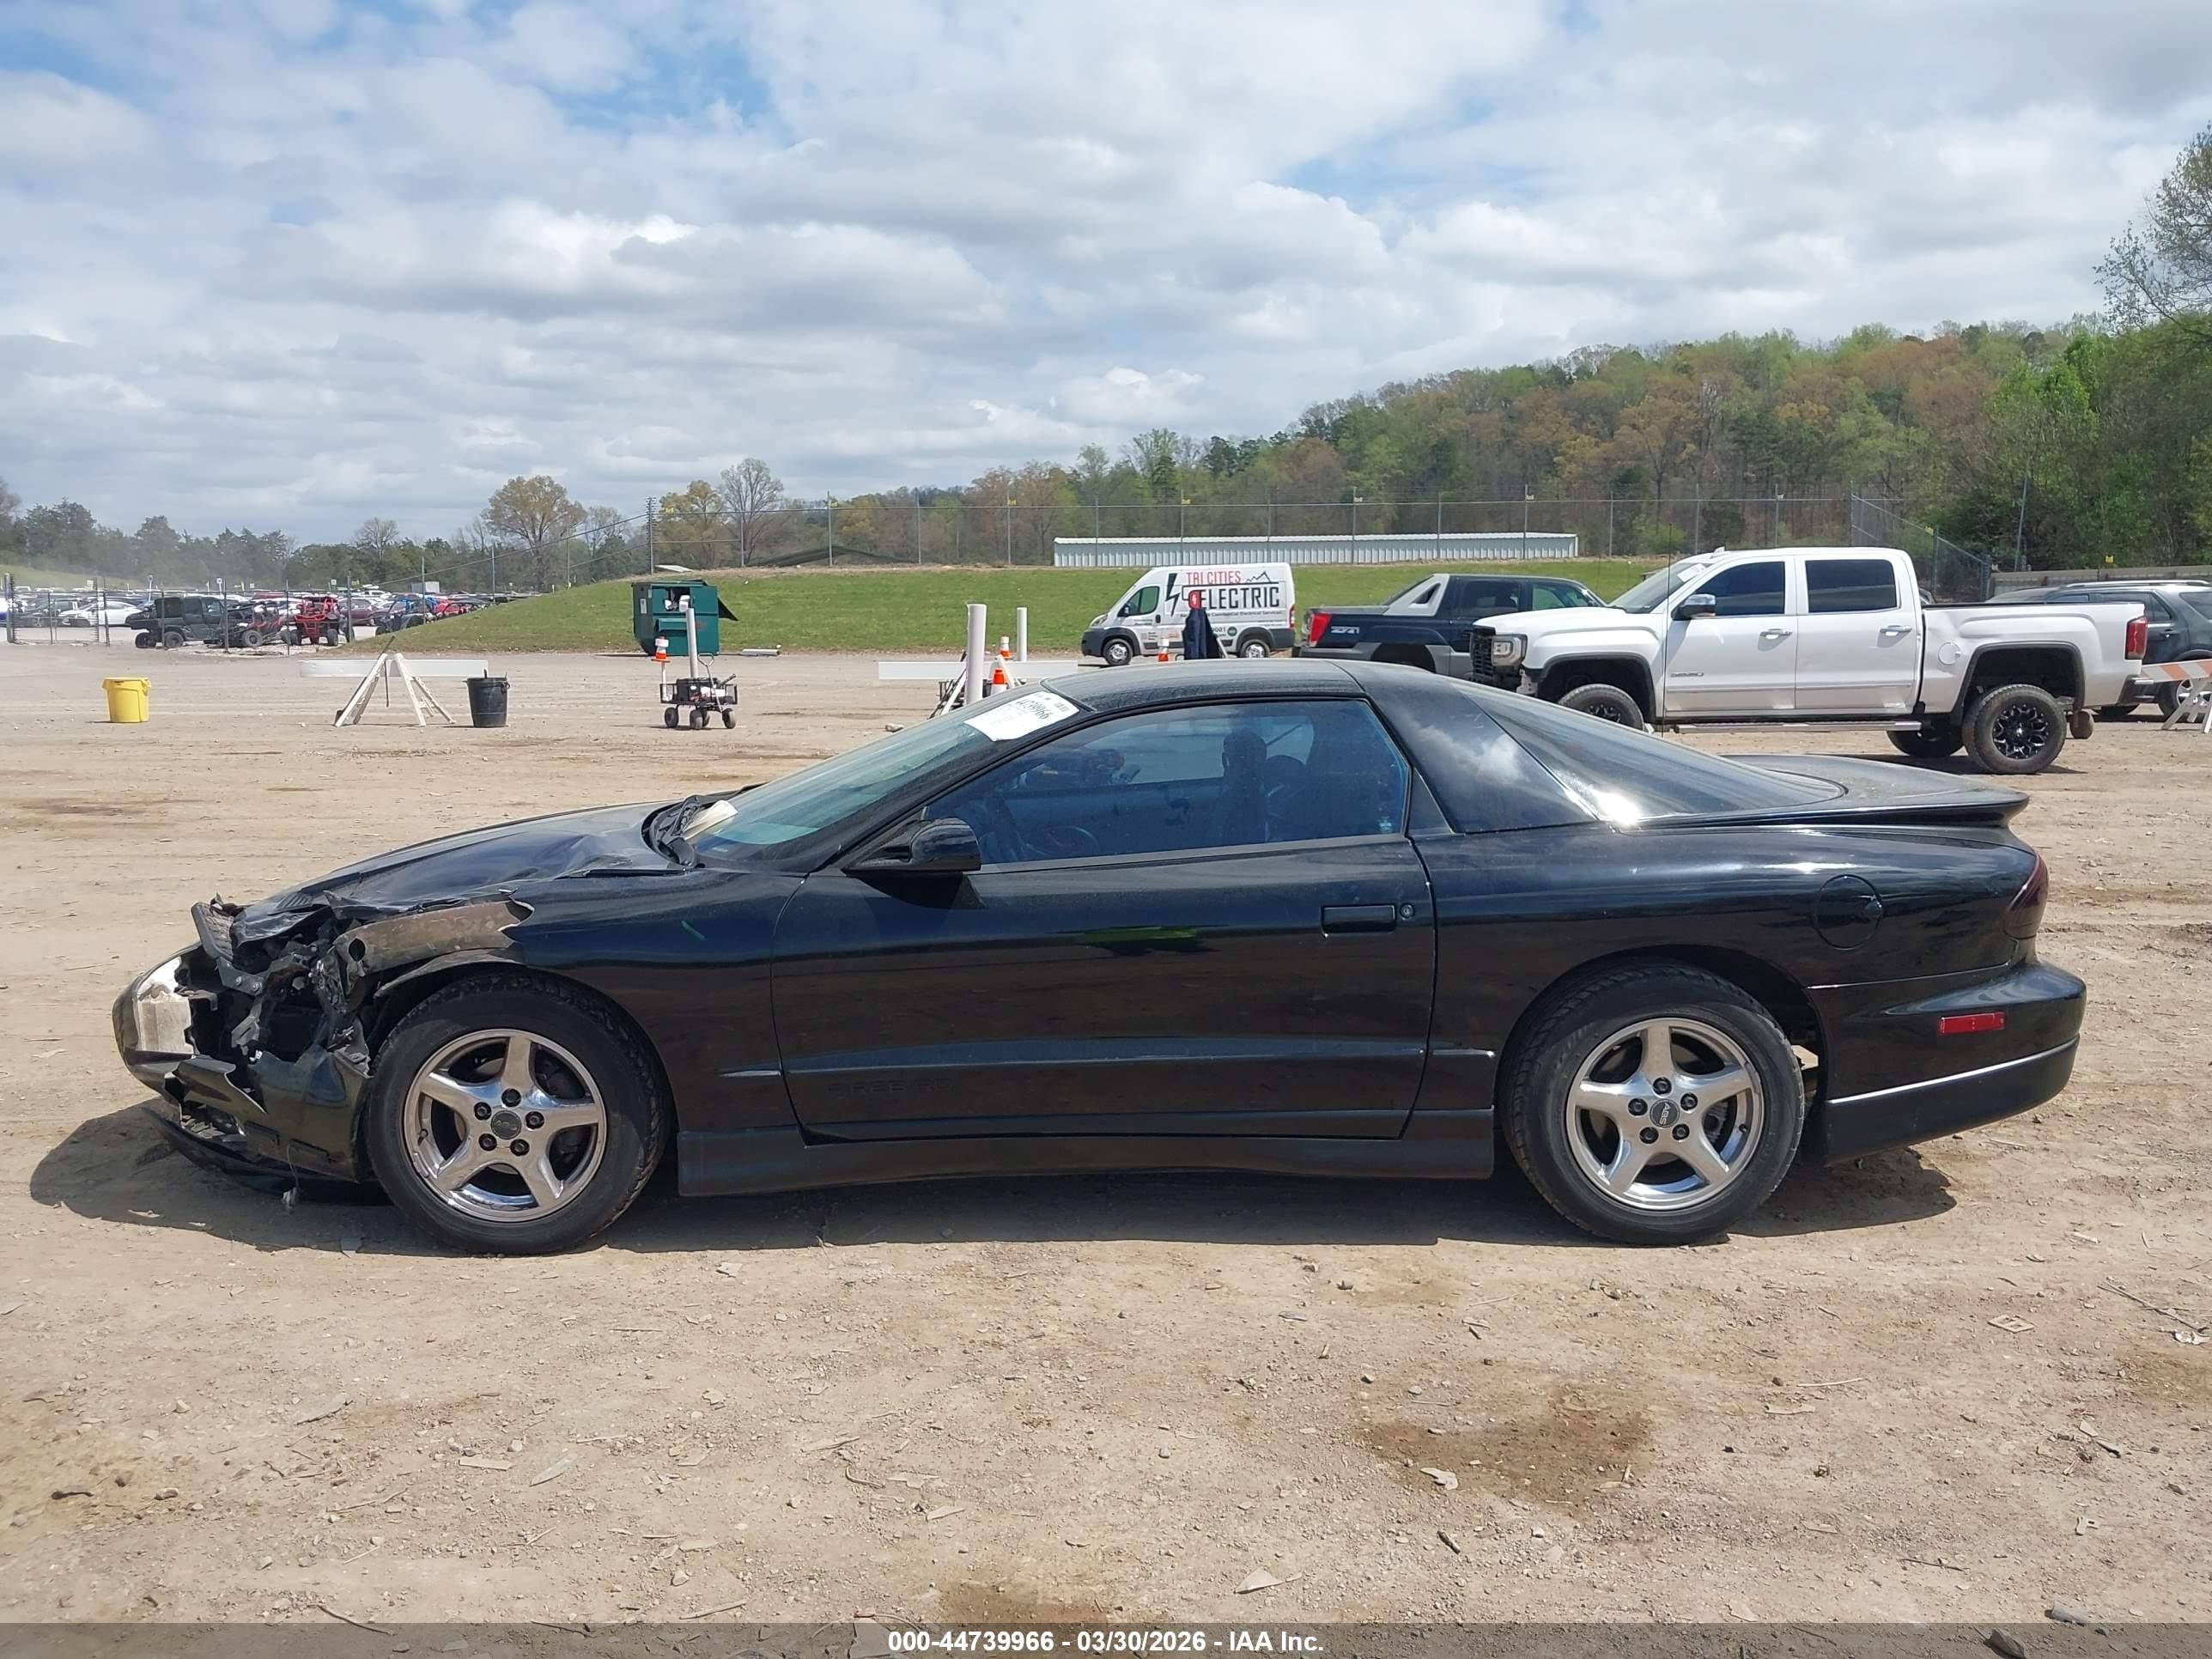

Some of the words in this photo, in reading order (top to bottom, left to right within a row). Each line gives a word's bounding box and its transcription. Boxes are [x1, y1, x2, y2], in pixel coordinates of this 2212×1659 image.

[1186, 572, 1203, 585] TRI
[1207, 570, 1242, 584] CITIES
[1200, 586, 1279, 610] ELECTRIC
